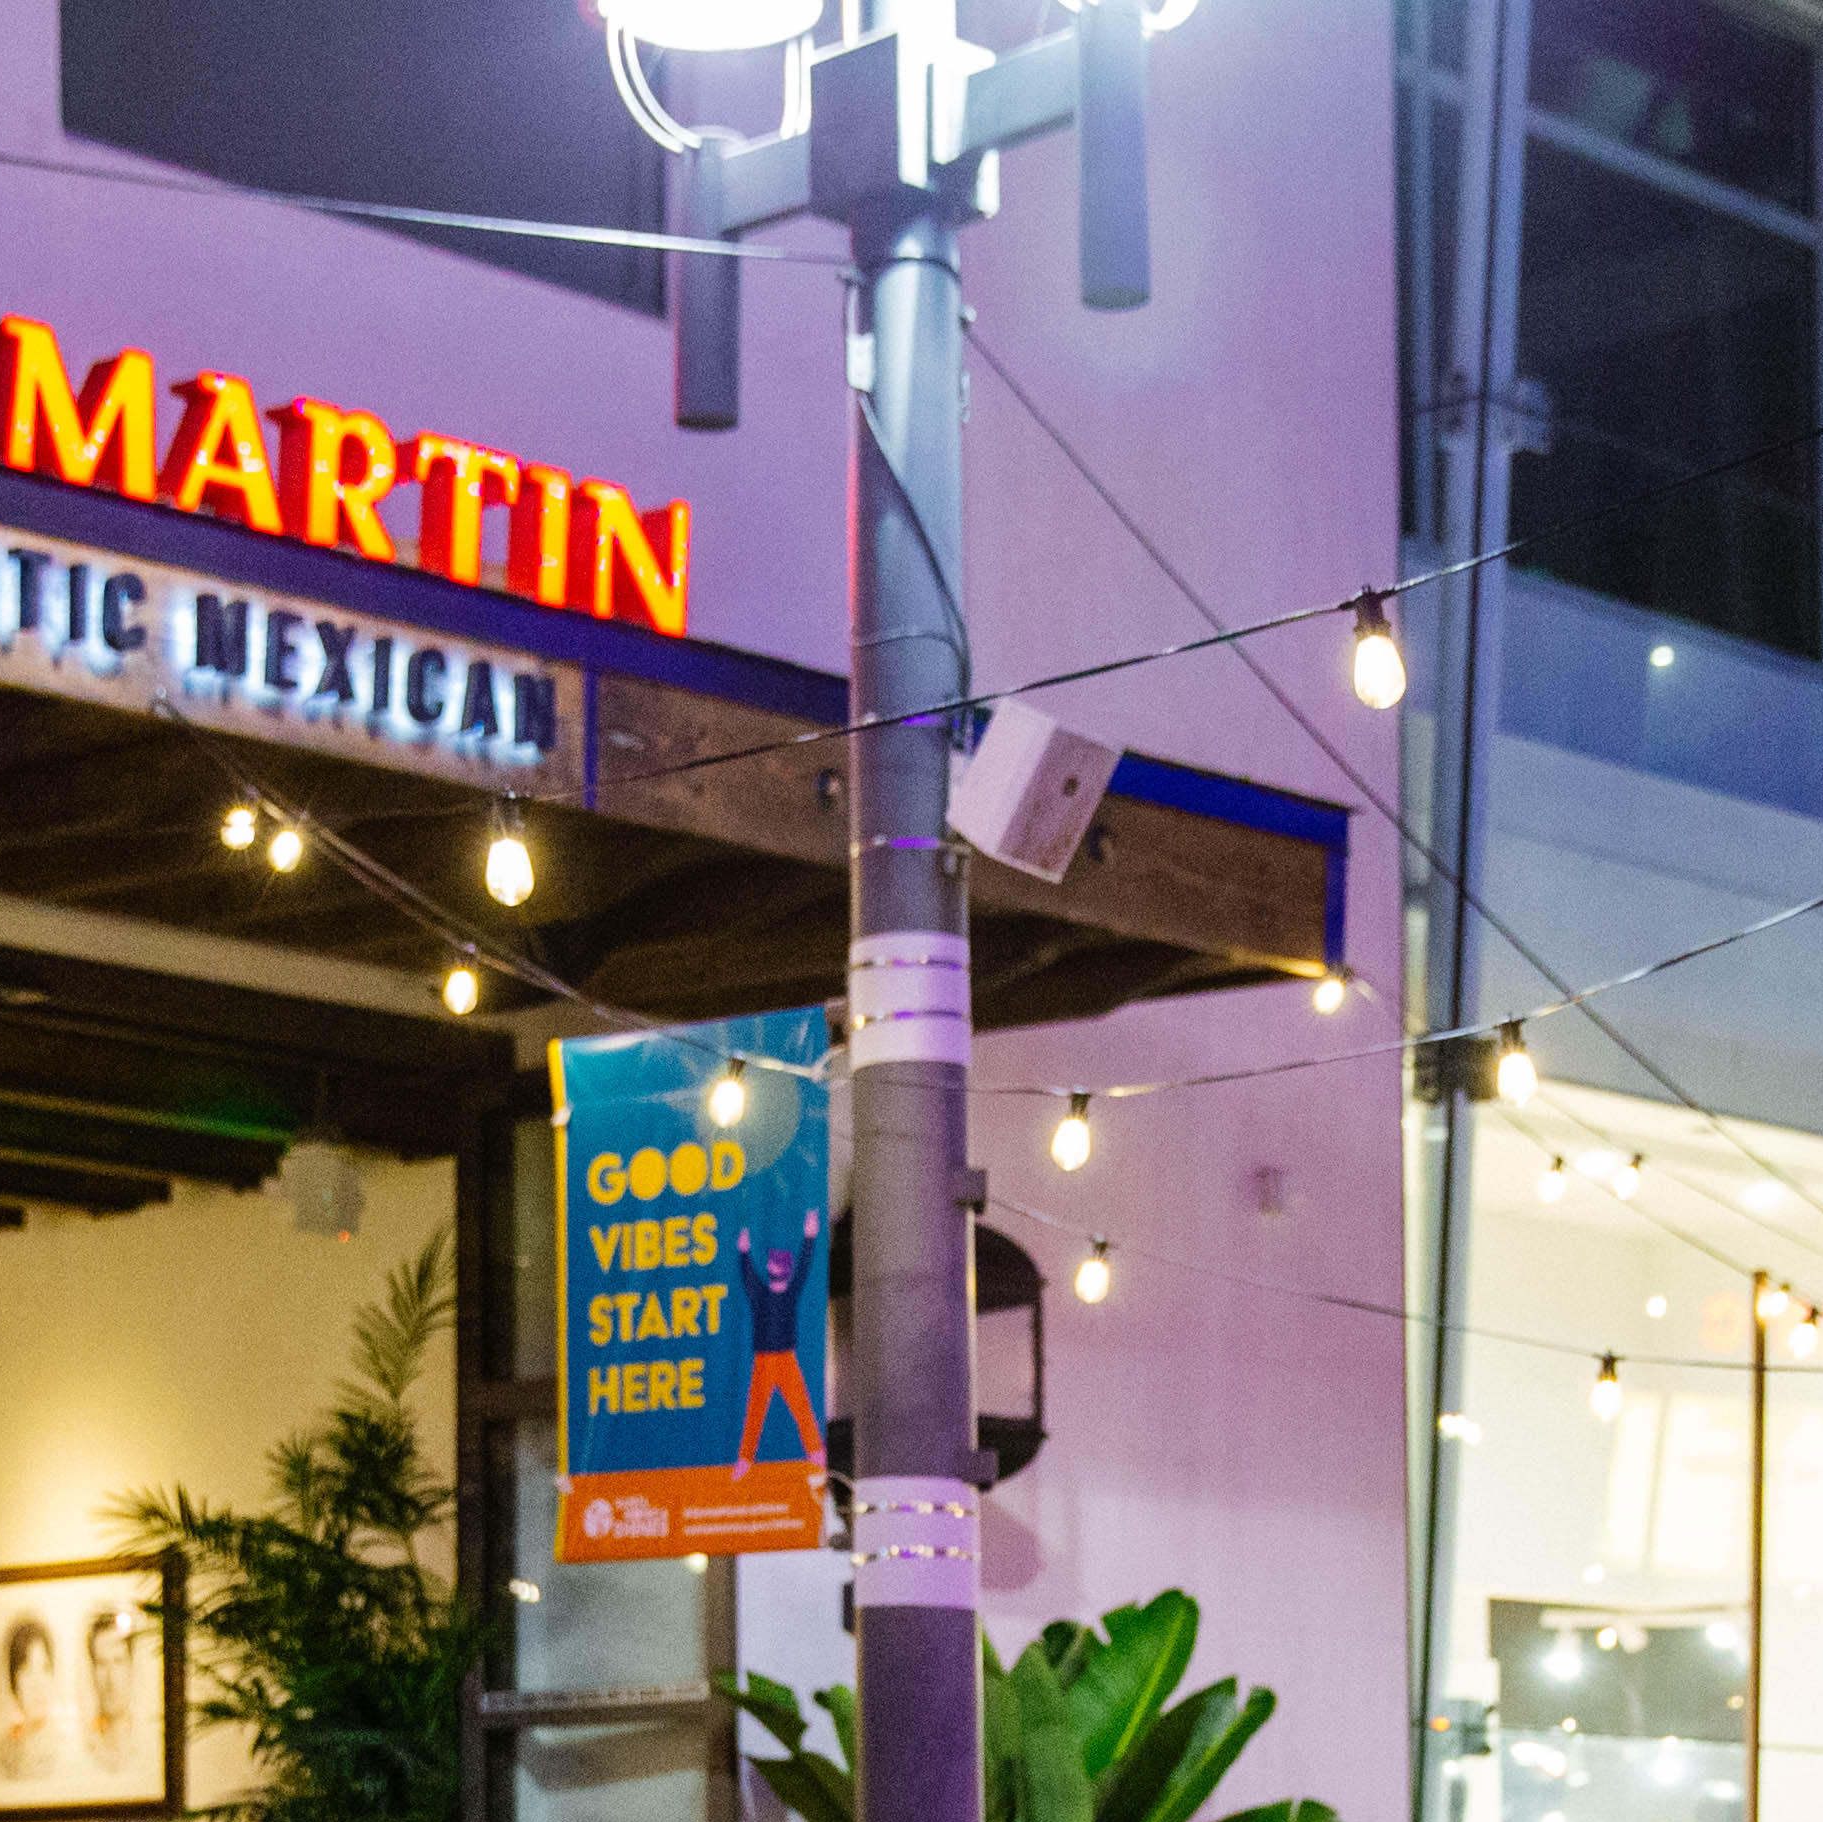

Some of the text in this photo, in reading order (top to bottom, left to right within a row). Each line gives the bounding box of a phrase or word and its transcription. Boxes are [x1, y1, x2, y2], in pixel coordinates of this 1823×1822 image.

[195, 592, 557, 752] MEXICAN
[587, 1139, 747, 1206] GOOD
[588, 1212, 719, 1273] VIBES
[588, 1283, 729, 1347] START
[588, 1357, 706, 1417] HERE
